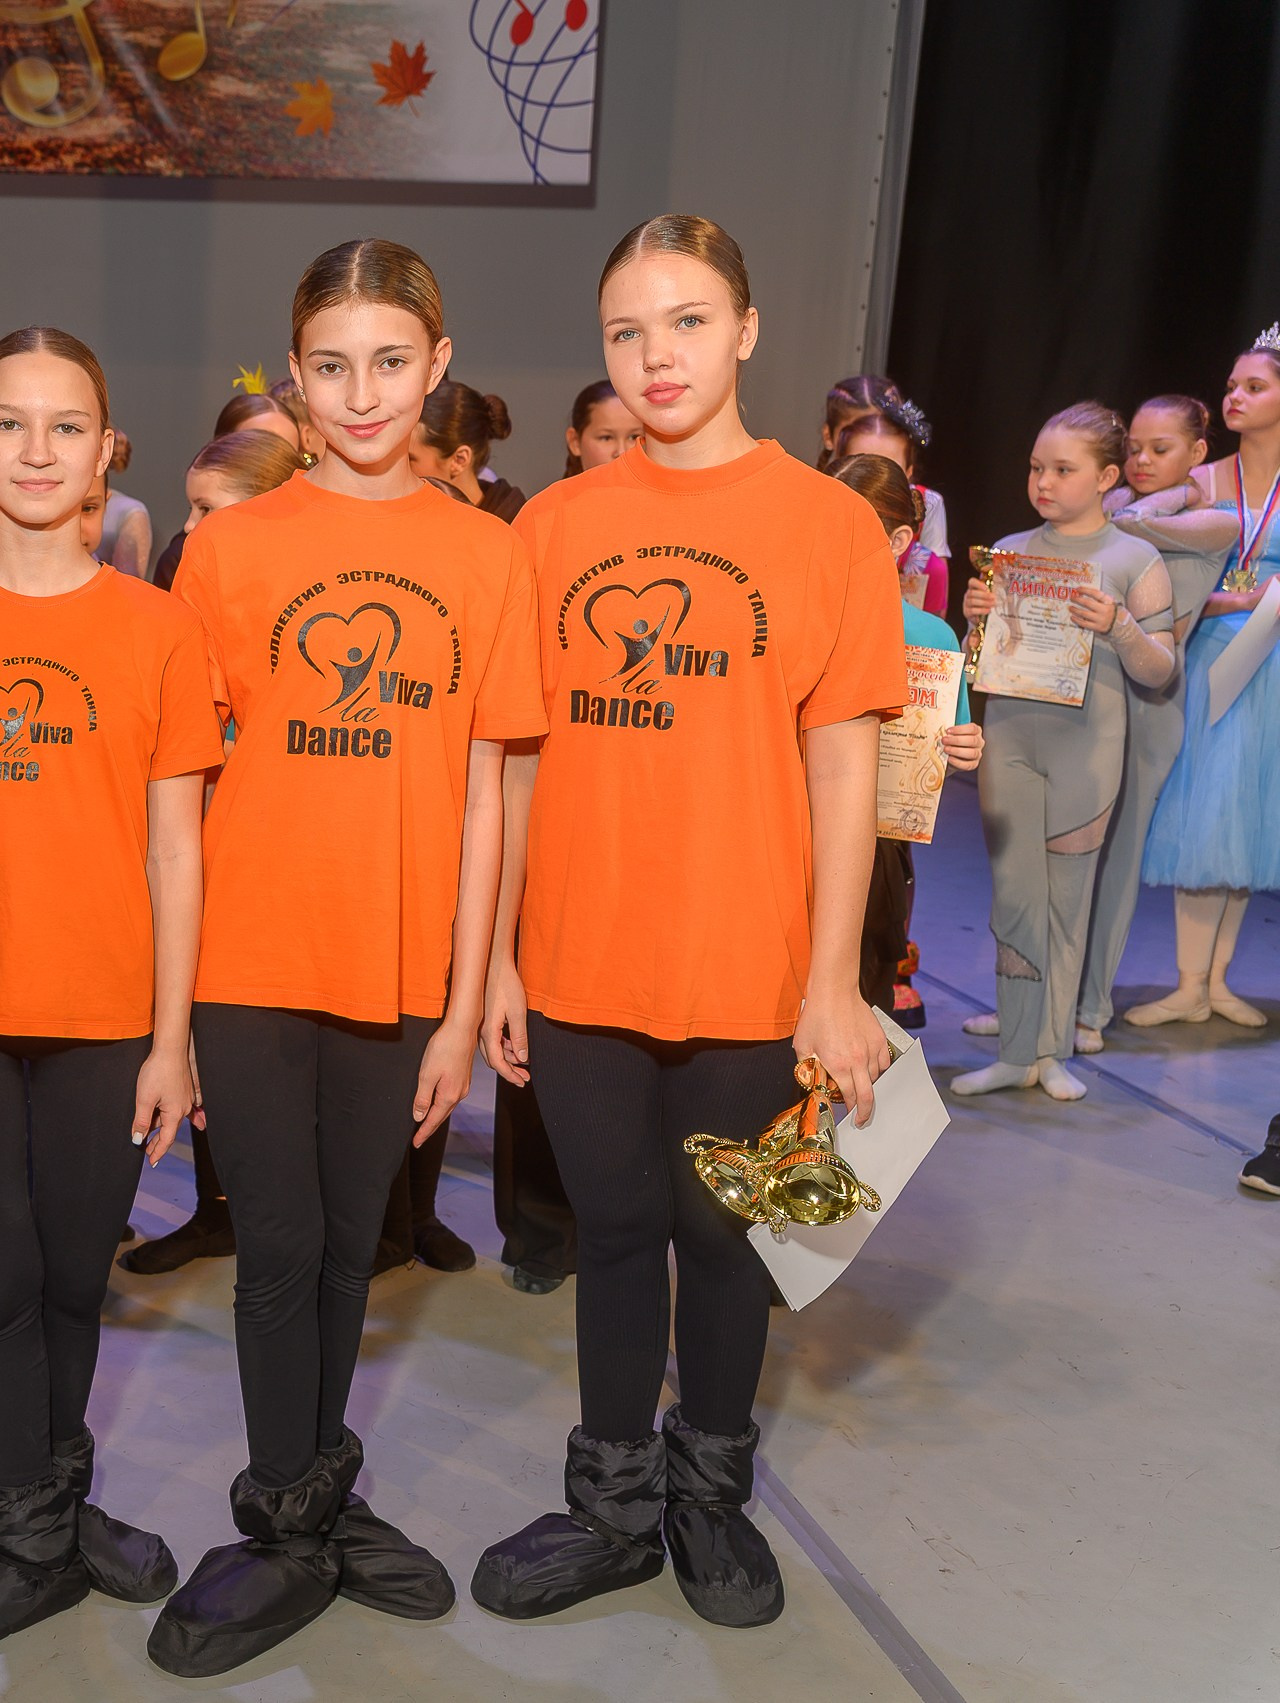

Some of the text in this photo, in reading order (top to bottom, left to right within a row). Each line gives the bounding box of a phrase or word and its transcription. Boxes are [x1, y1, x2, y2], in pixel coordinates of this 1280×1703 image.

[557, 545, 768, 658] КОЛЛЕКТИВ ЭСТРАДНОГО ТАНЦА
[336, 570, 449, 618] ЭСТРАДНОГО
[446, 625, 462, 694] ТАНЦА
[621, 659, 663, 695] la
[663, 643, 729, 677] Viva
[2, 656, 80, 682] ЭСТРАДНОГО
[80, 685, 98, 732] ТАНЦА
[339, 687, 380, 723] la
[378, 670, 434, 710] Viva
[570, 689, 675, 731] Dance
[2, 733, 31, 758] la
[29, 721, 73, 745] Viva
[287, 719, 392, 759] Dance
